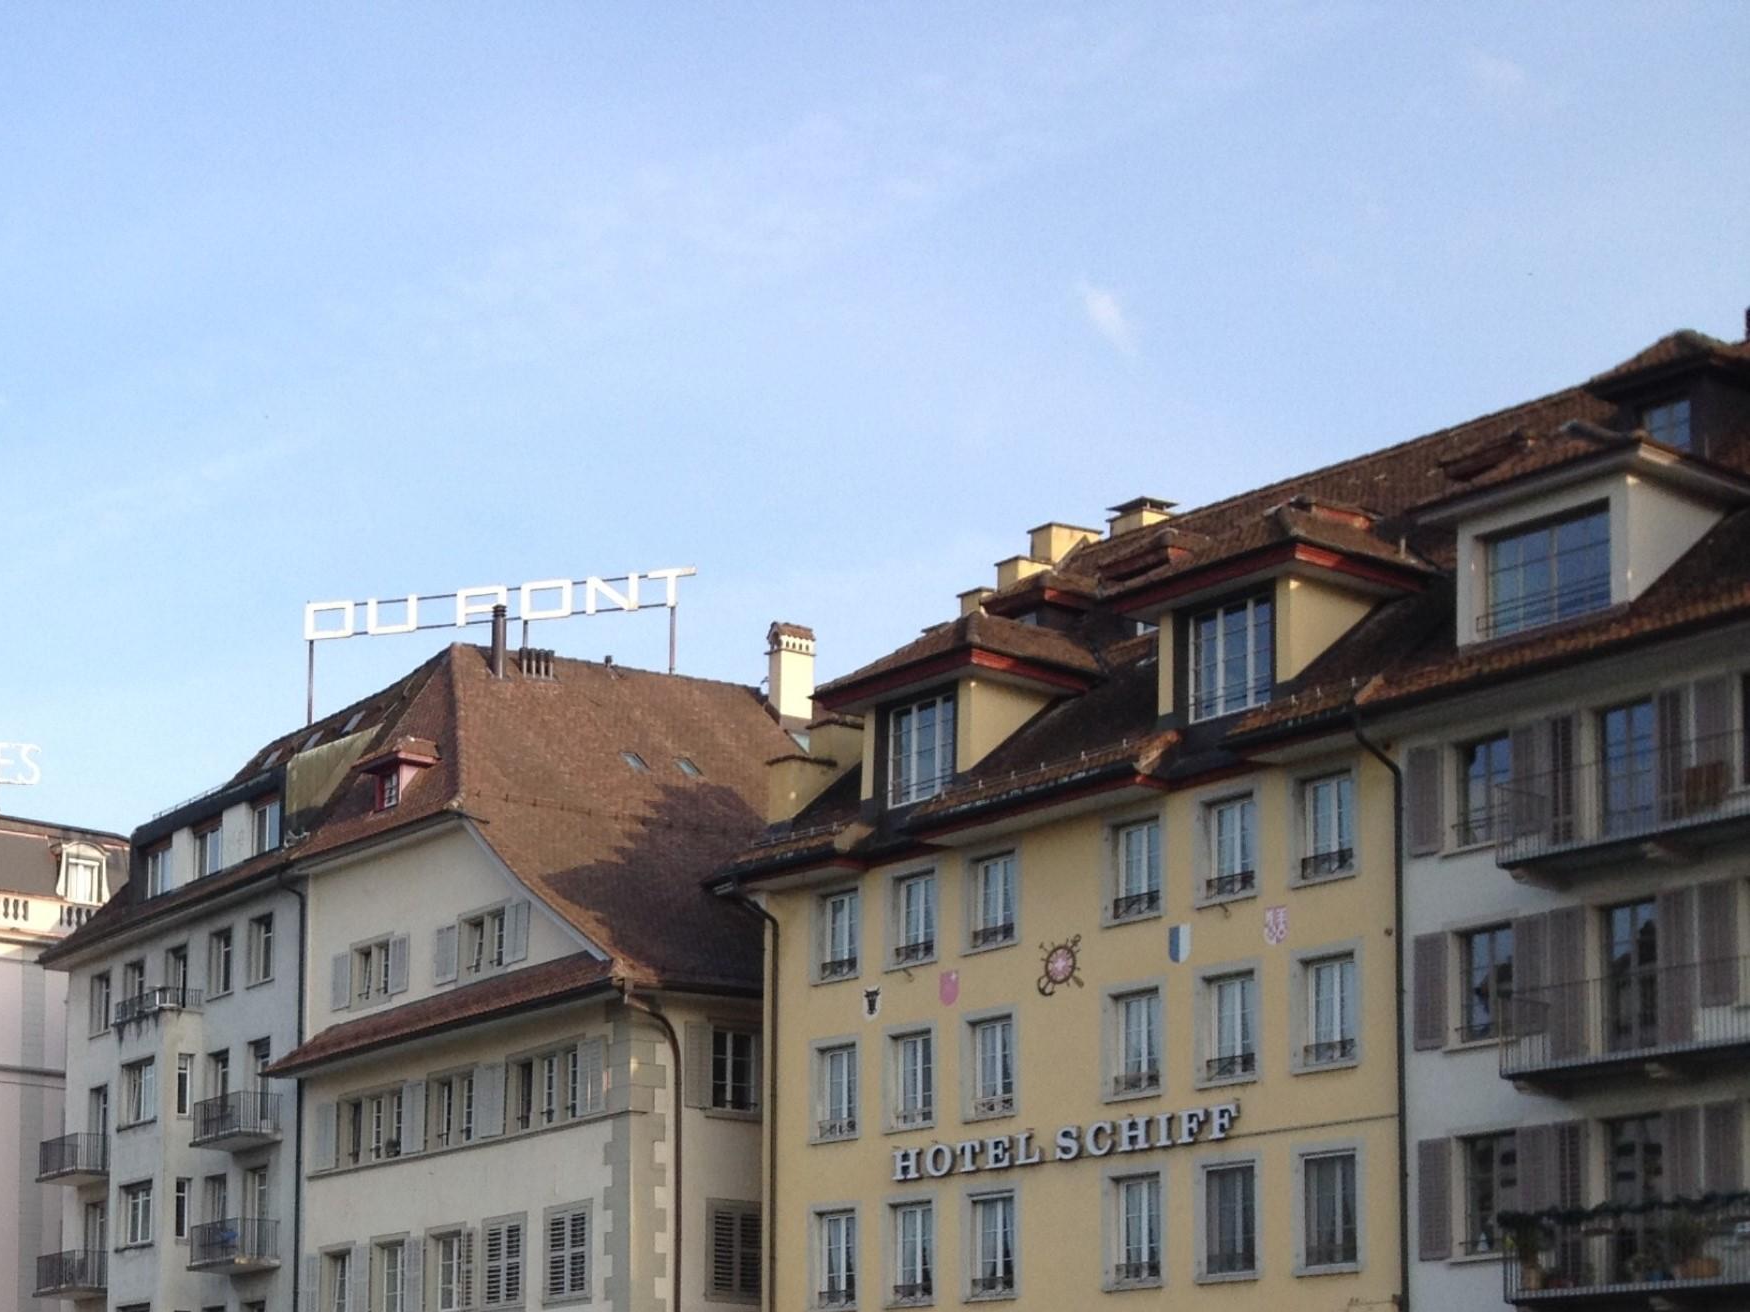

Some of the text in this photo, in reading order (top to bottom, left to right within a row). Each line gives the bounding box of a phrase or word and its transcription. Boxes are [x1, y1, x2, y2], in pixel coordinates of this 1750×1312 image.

[304, 565, 698, 641] DU PONT
[891, 1102, 1241, 1182] HOTEL SCHIFF
